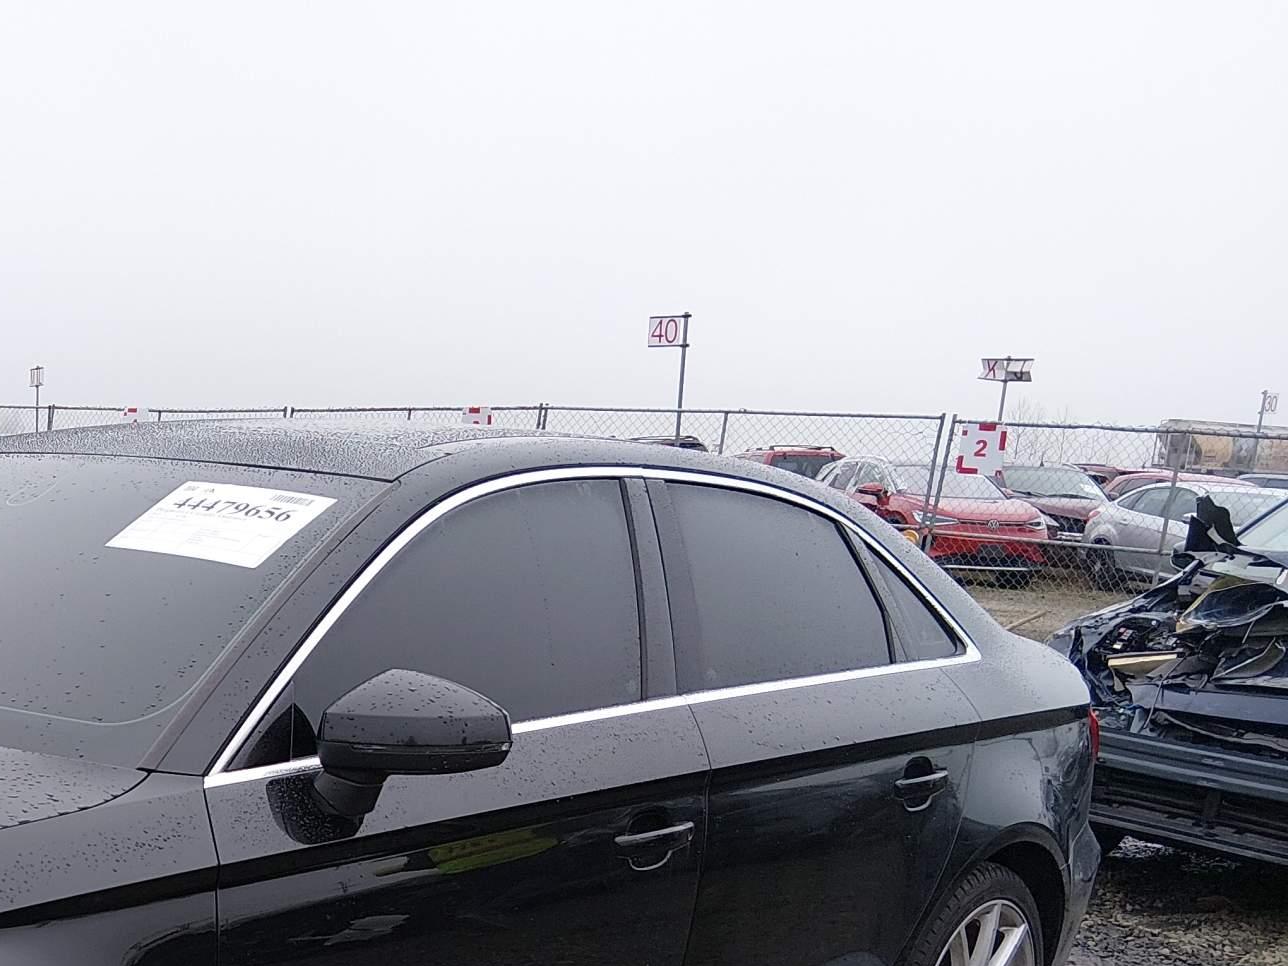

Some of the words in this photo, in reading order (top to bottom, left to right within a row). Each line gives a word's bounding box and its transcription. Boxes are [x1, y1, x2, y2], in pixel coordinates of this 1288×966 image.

[651, 317, 679, 344] 40
[1264, 395, 1278, 412] 30
[973, 439, 988, 458] 2
[173, 495, 297, 523] 44479656
